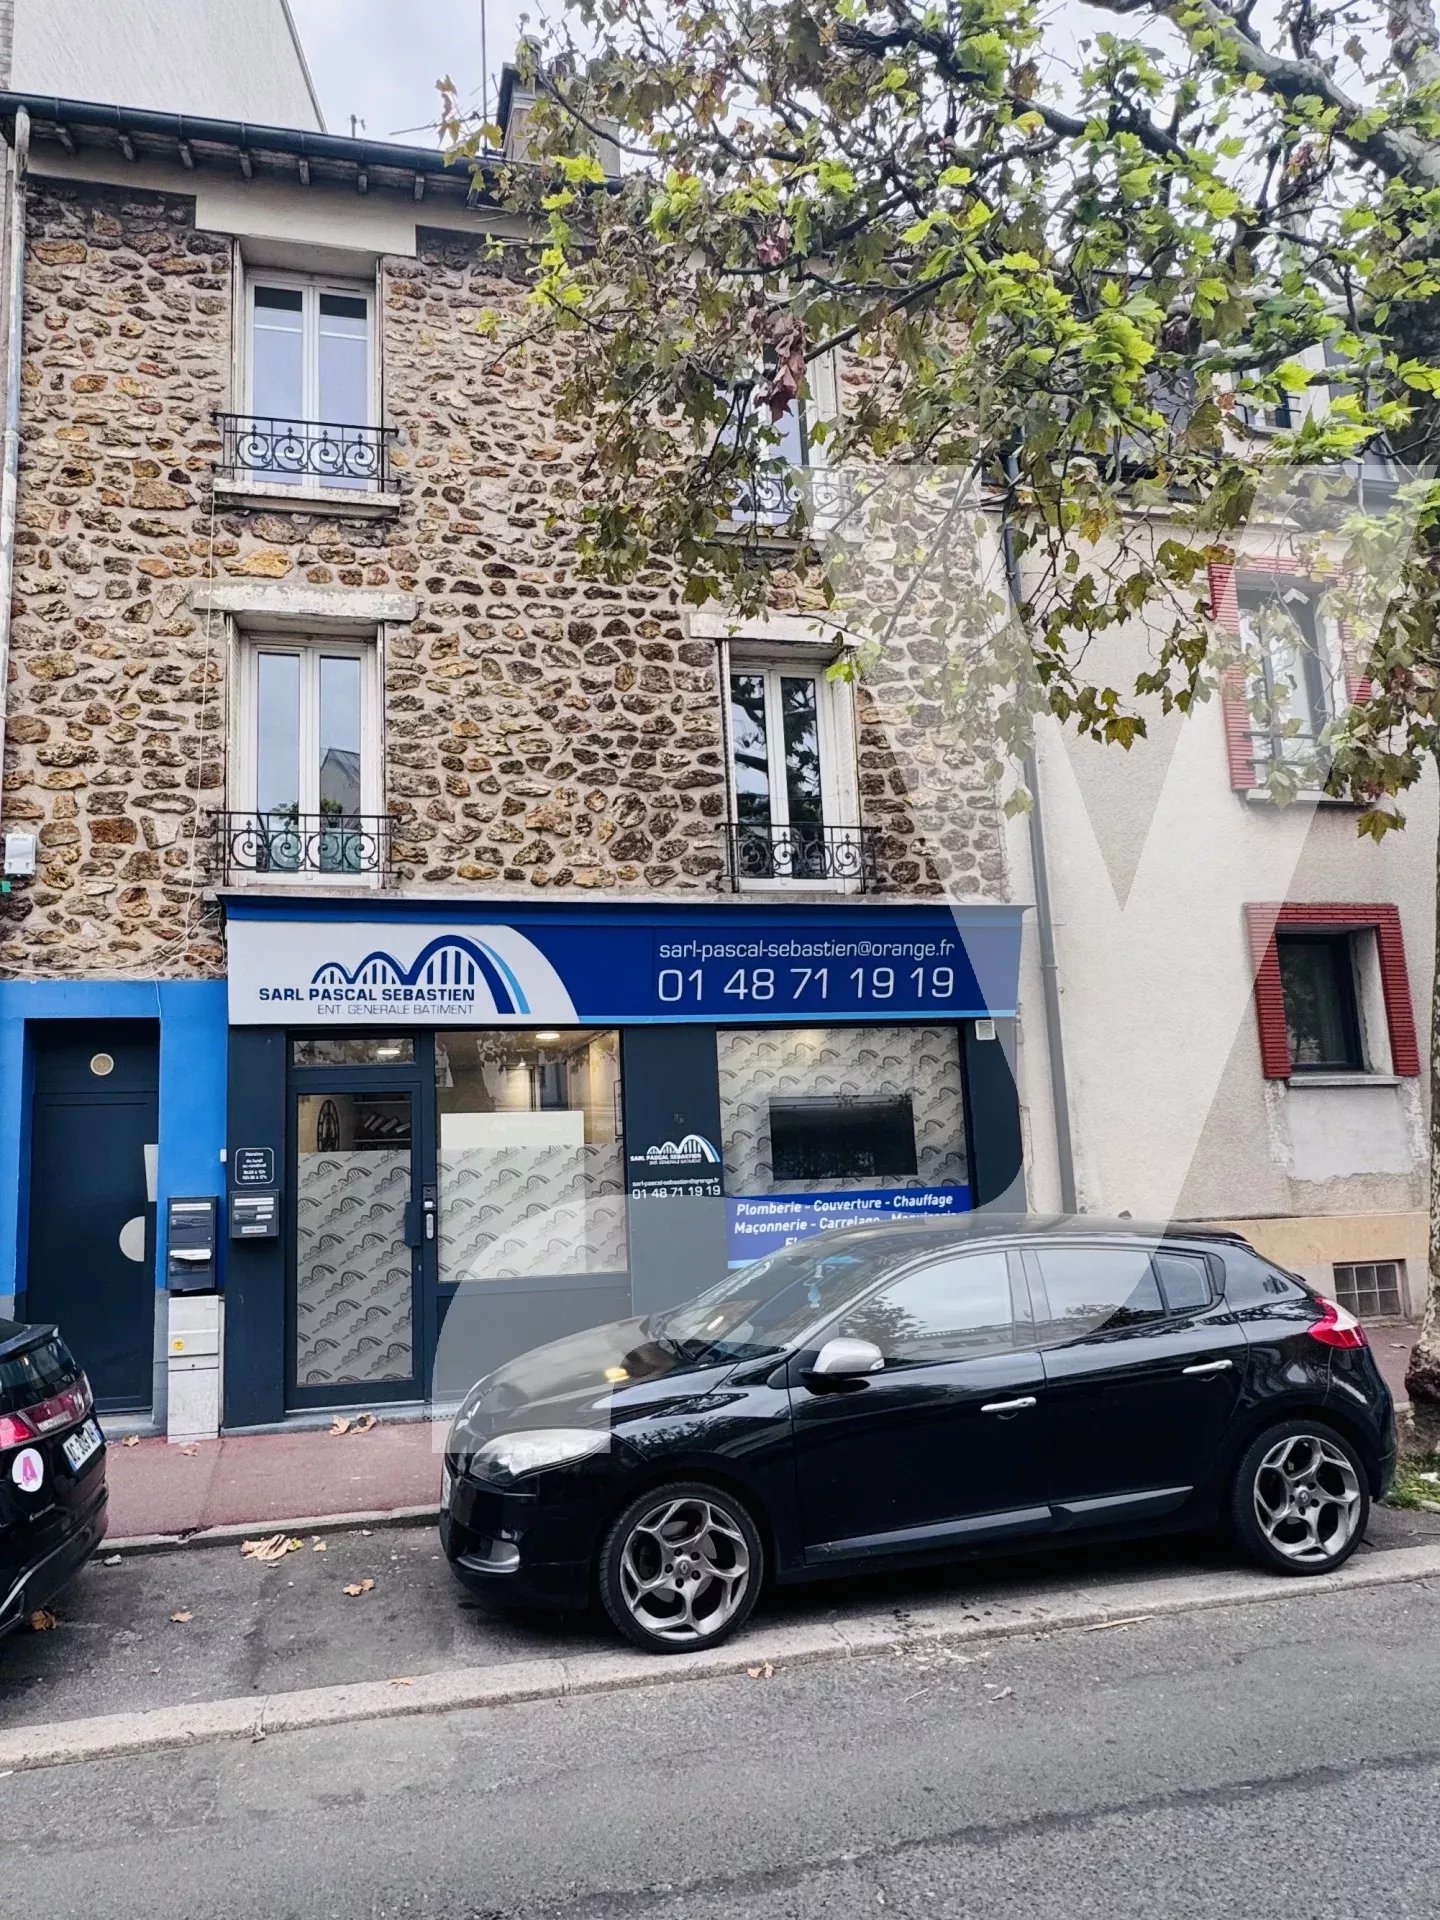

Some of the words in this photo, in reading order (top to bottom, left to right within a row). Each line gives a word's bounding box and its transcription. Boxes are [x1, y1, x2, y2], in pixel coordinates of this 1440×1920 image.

[658, 939, 955, 962] sarl-pascal-sebastien@orange.fr
[658, 968, 703, 1002] 01
[723, 968, 775, 1000] 48
[790, 968, 828, 999] 71
[849, 967, 895, 999] 19
[910, 967, 954, 998] 19
[259, 988, 304, 1001] SARL
[309, 988, 377, 1001] PASCAL
[382, 988, 475, 1001] SEBASTIEN
[348, 1004, 410, 1015] GENERALE
[413, 1004, 474, 1015] BATIMENT
[632, 1189, 647, 1200] 01
[651, 1188, 668, 1198] 48
[670, 1187, 683, 1197] 71
[688, 1186, 703, 1197] 19
[706, 1185, 721, 1196] 19
[736, 1201, 802, 1216] Plomberie
[813, 1198, 882, 1212] Couverture
[893, 1194, 953, 1208] Chauffage
[734, 1218, 807, 1235] Maçonnerie
